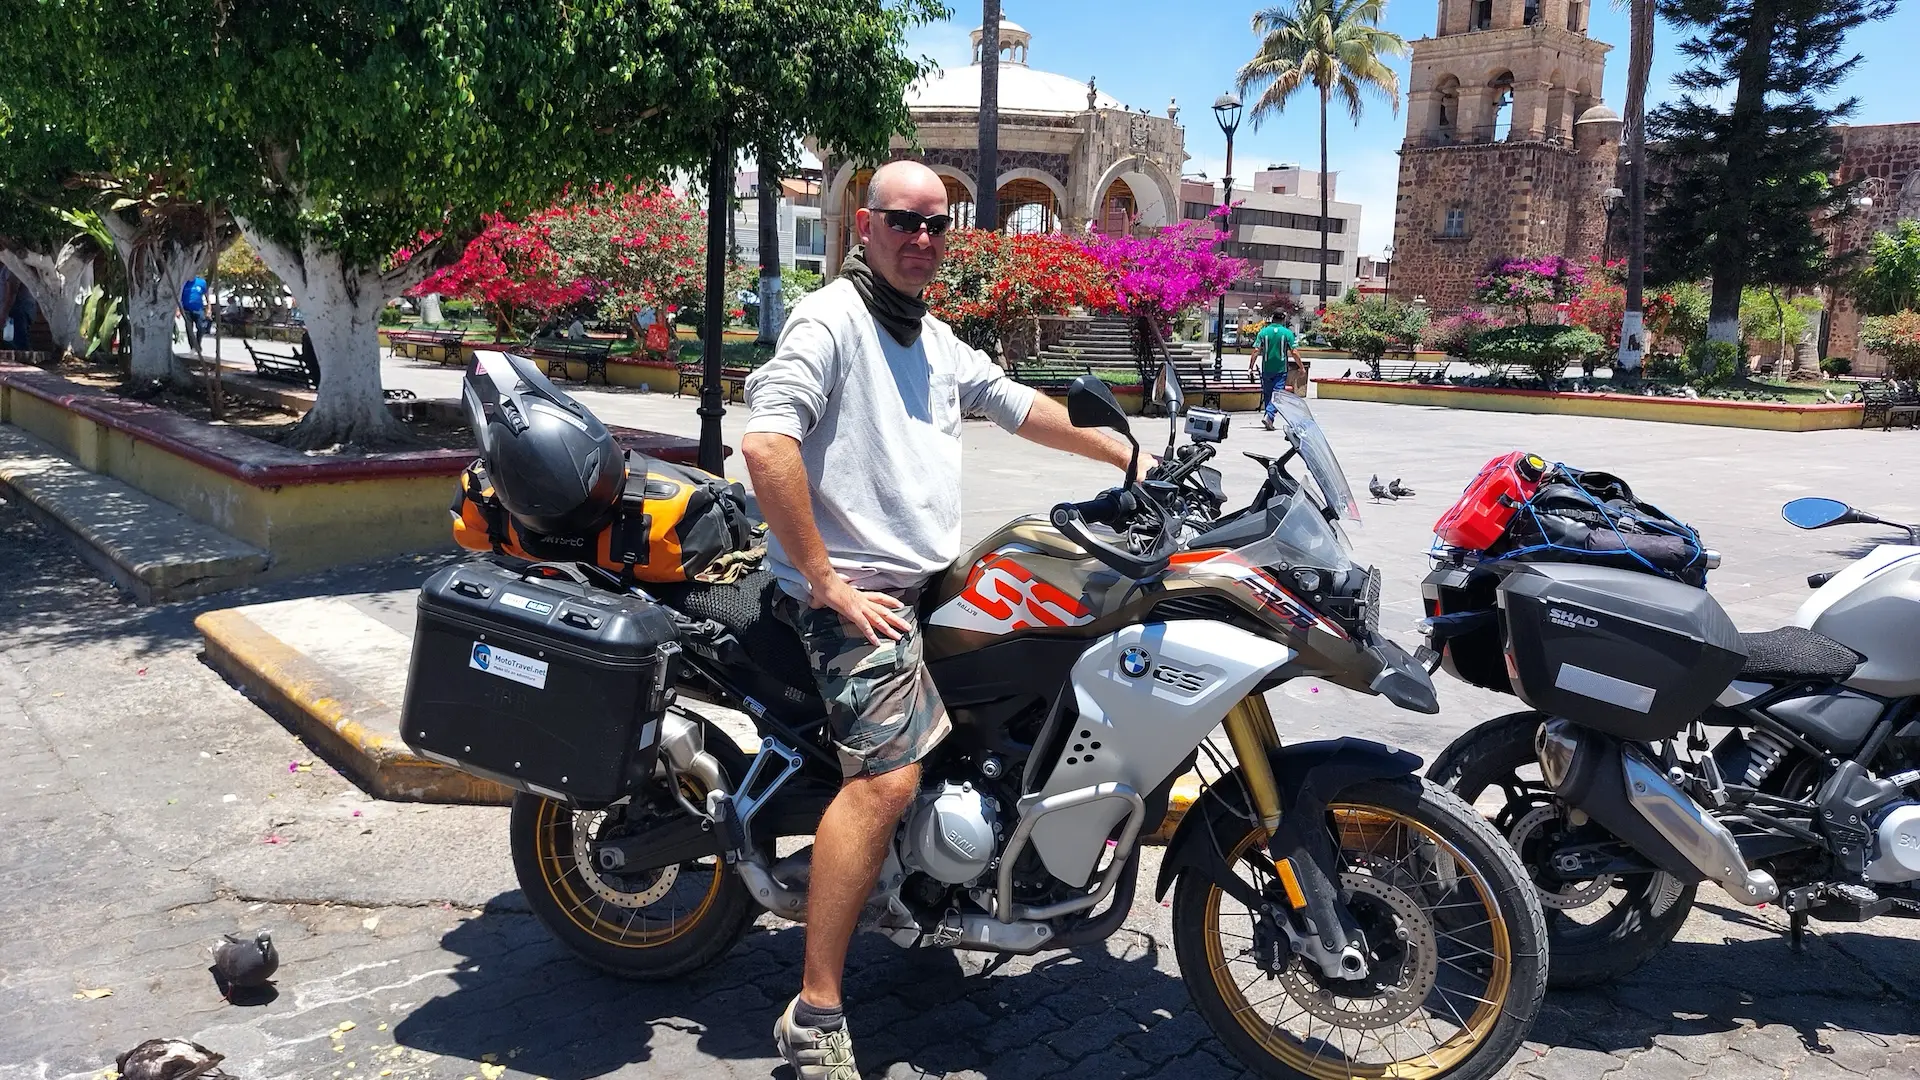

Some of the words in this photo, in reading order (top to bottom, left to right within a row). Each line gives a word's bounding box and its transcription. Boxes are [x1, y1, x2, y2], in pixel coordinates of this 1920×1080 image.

[1549, 608, 1599, 627] SHAD
[494, 654, 546, 676] MotoTravel.net
[1152, 664, 1206, 692] GS
[948, 829, 976, 853] BMW
